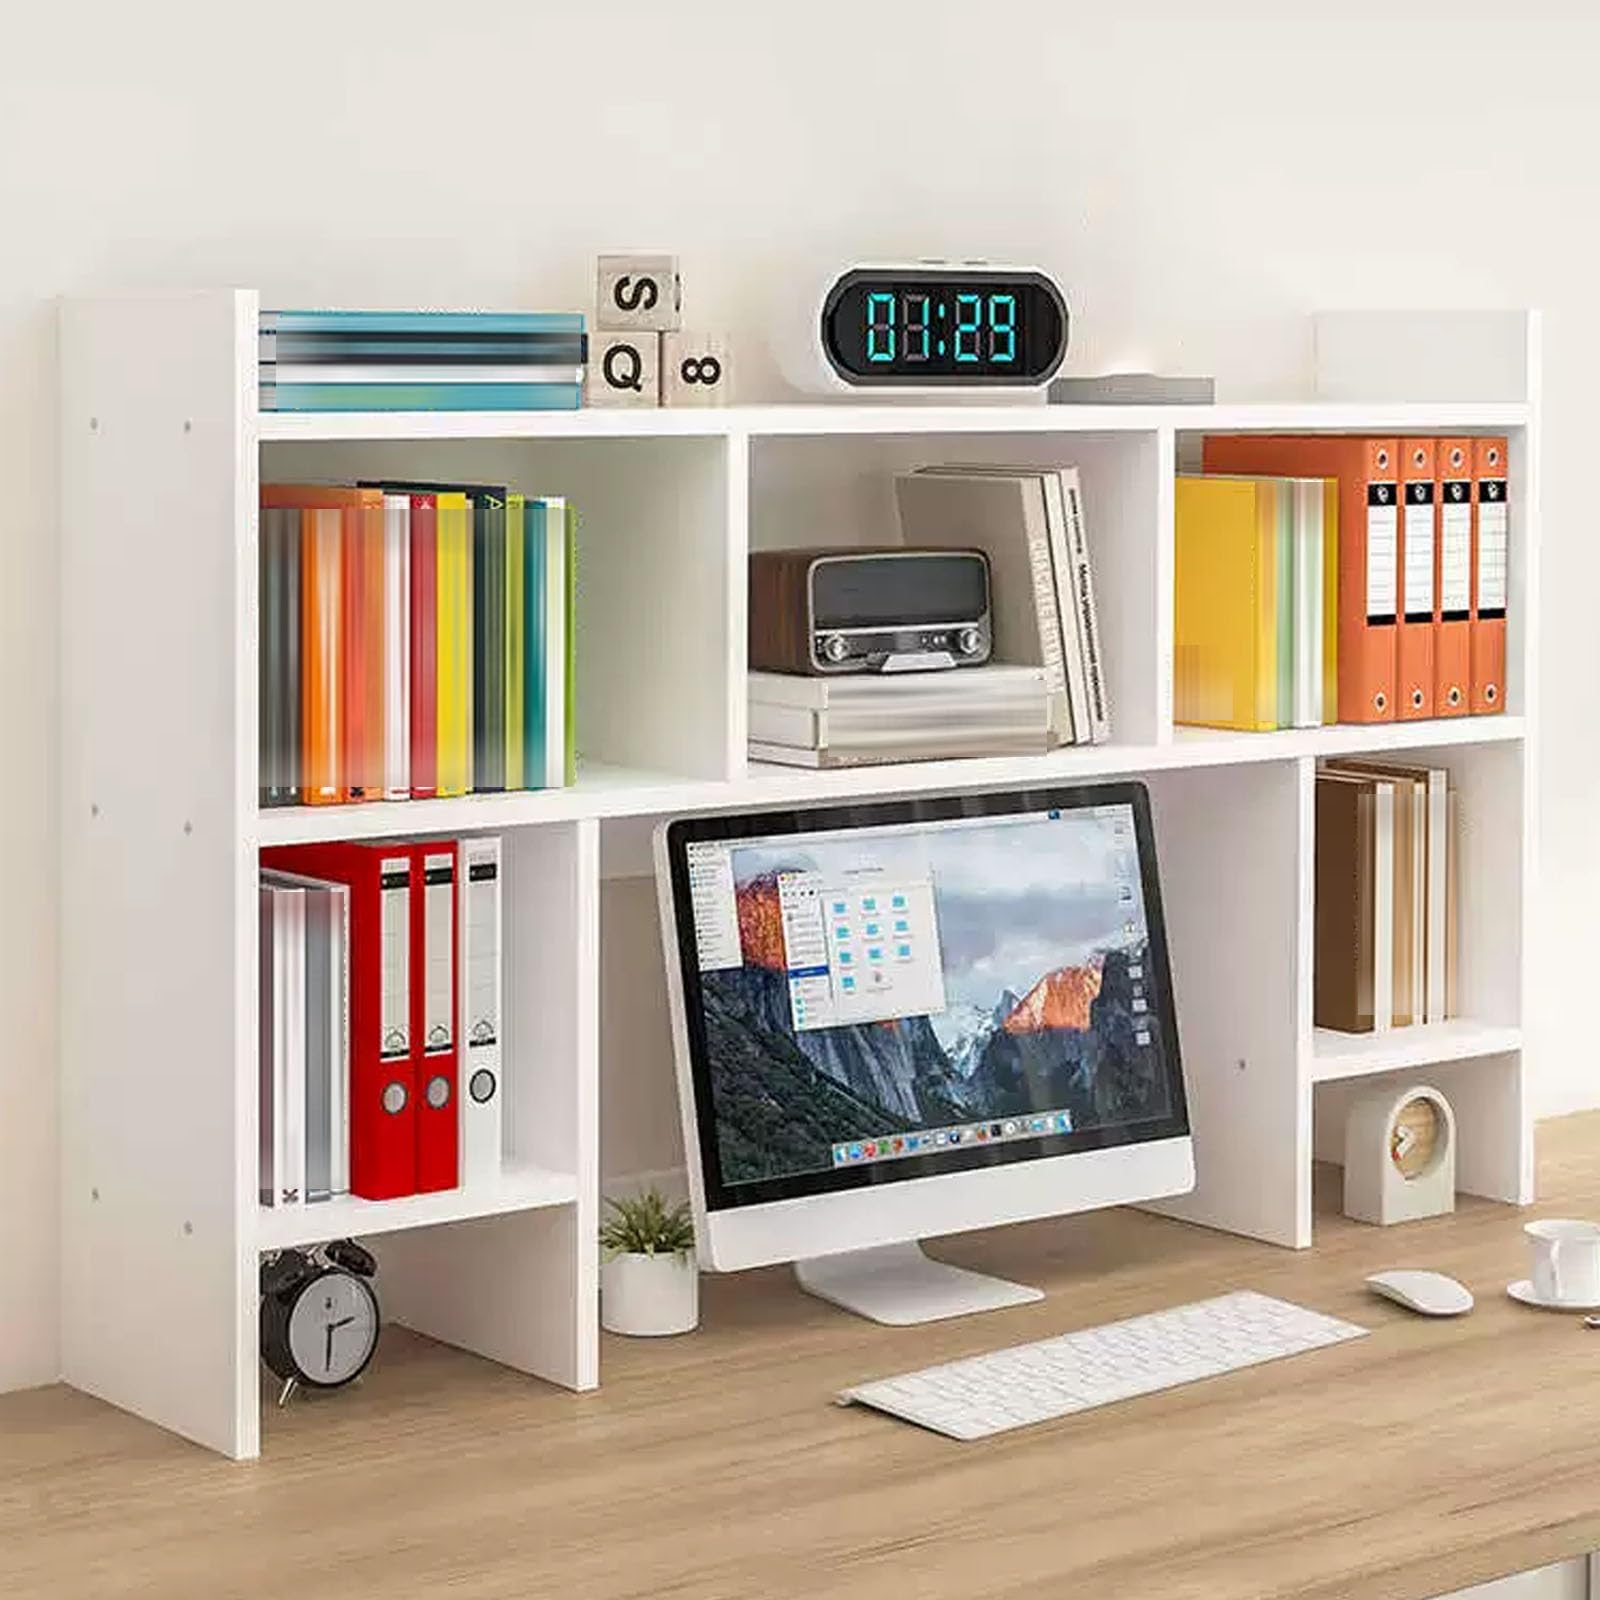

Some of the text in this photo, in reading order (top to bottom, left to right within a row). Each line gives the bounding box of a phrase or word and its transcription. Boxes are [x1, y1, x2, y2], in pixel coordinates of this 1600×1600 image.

[614, 276, 658, 311] S
[866, 293, 1016, 362] 01:29
[603, 344, 642, 392] Q
[681, 357, 721, 385] 8
